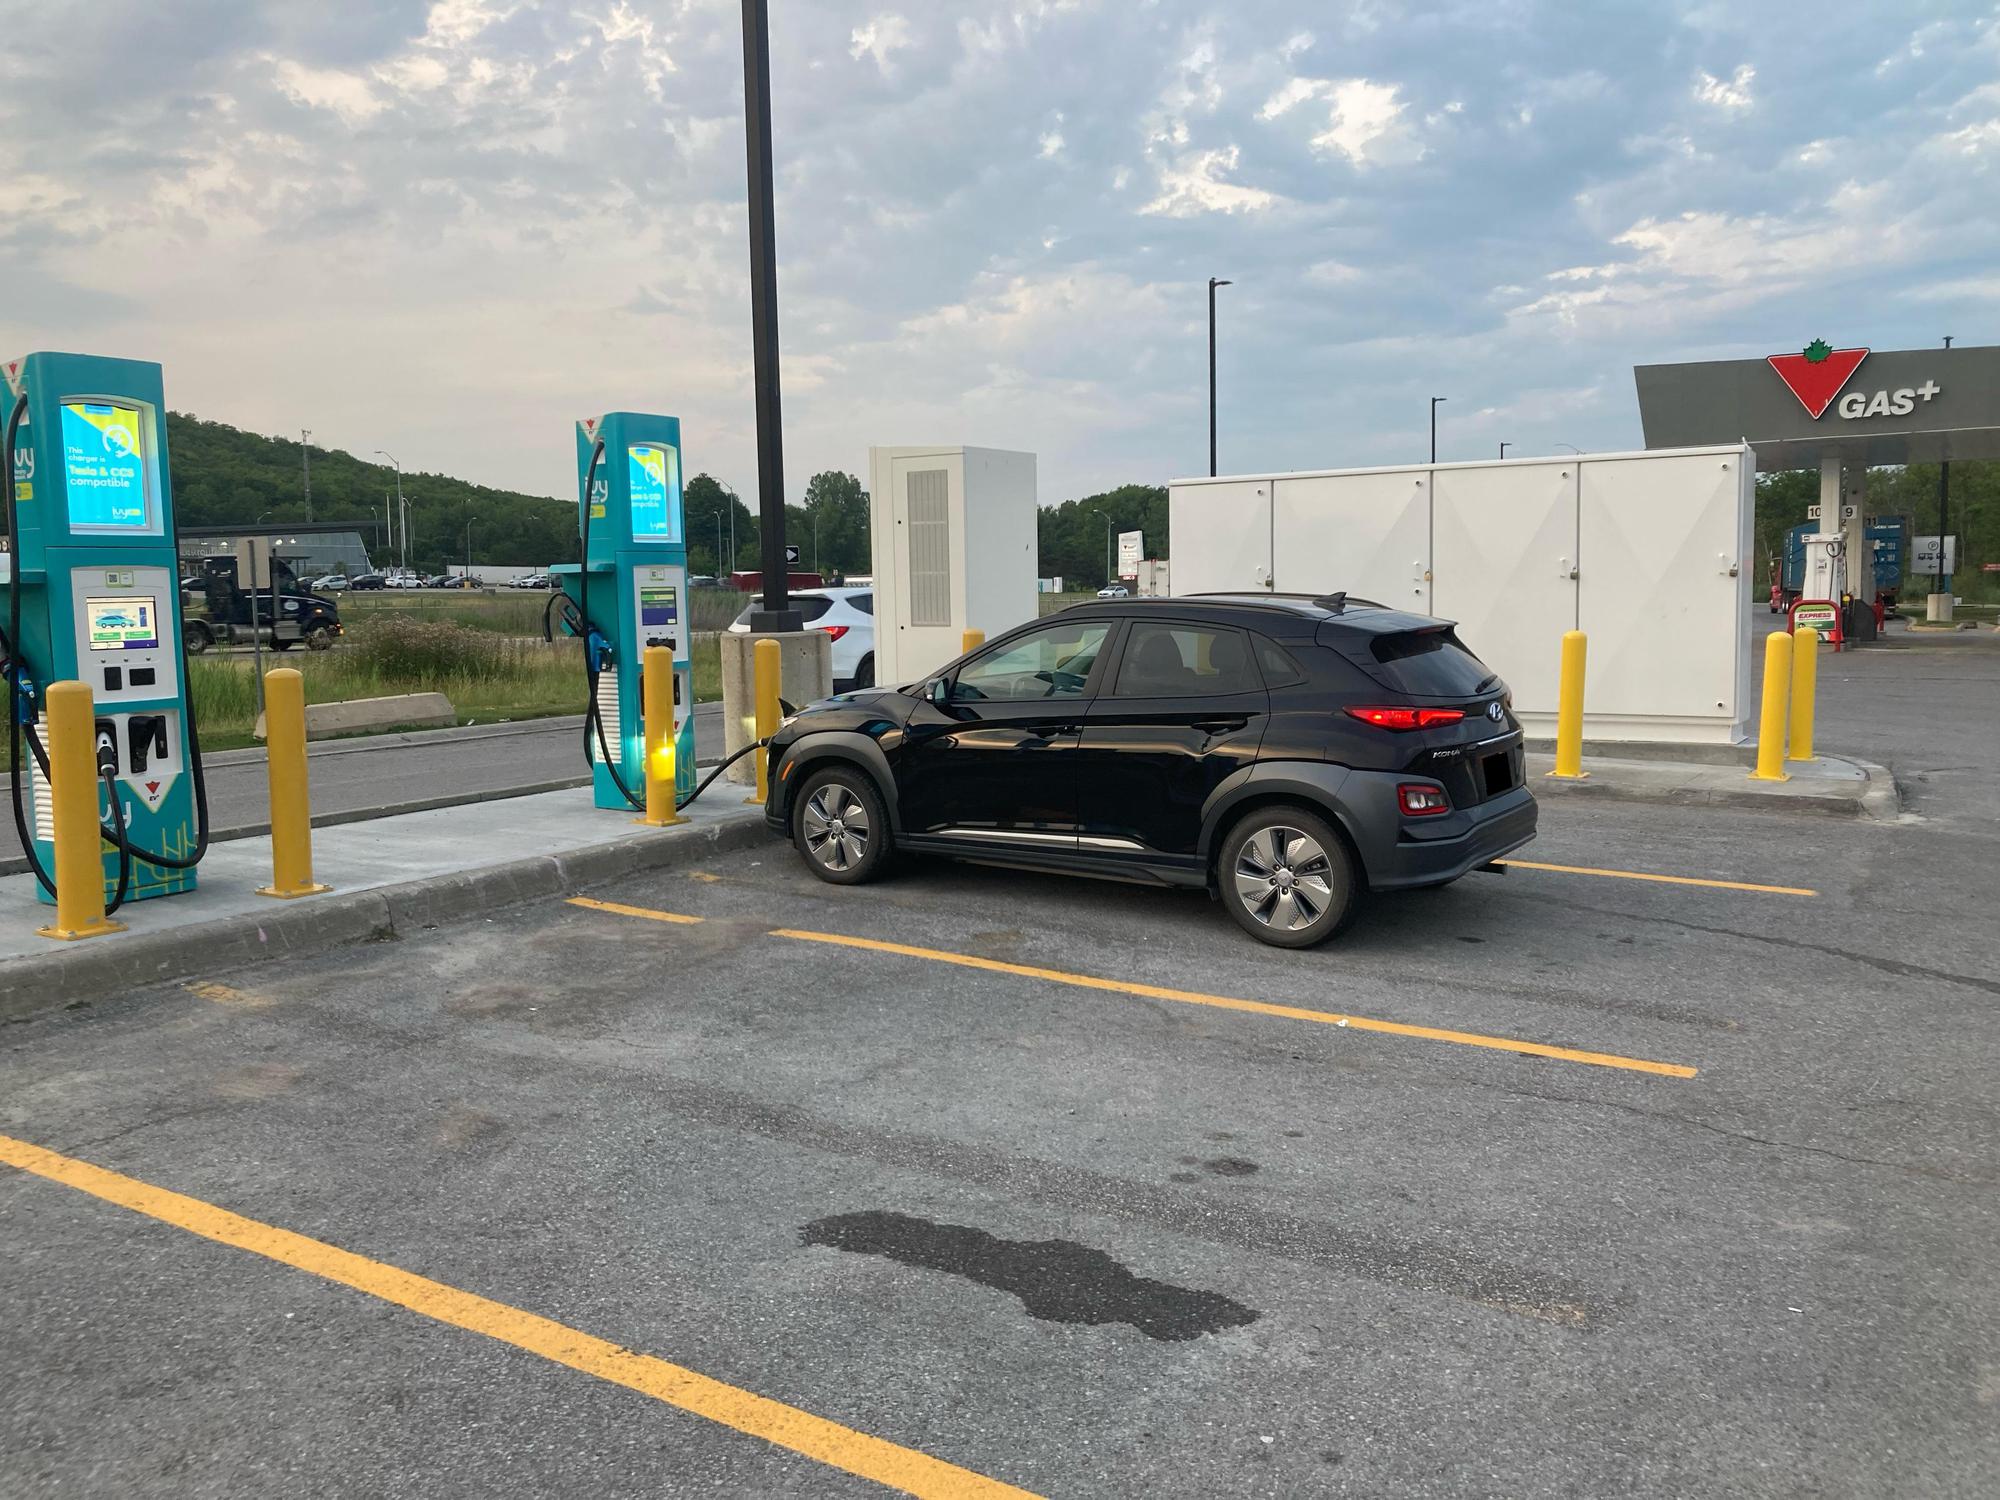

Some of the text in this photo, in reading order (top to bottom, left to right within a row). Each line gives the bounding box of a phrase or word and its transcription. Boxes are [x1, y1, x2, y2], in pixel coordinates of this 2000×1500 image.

[14, 447, 34, 478] vy
[67, 455, 98, 463] charger
[110, 467, 134, 477] CCS
[70, 478, 130, 488] compatible
[1809, 507, 1821, 517] 10
[1845, 507, 1853, 517] 9
[1433, 748, 1460, 758] KONA
